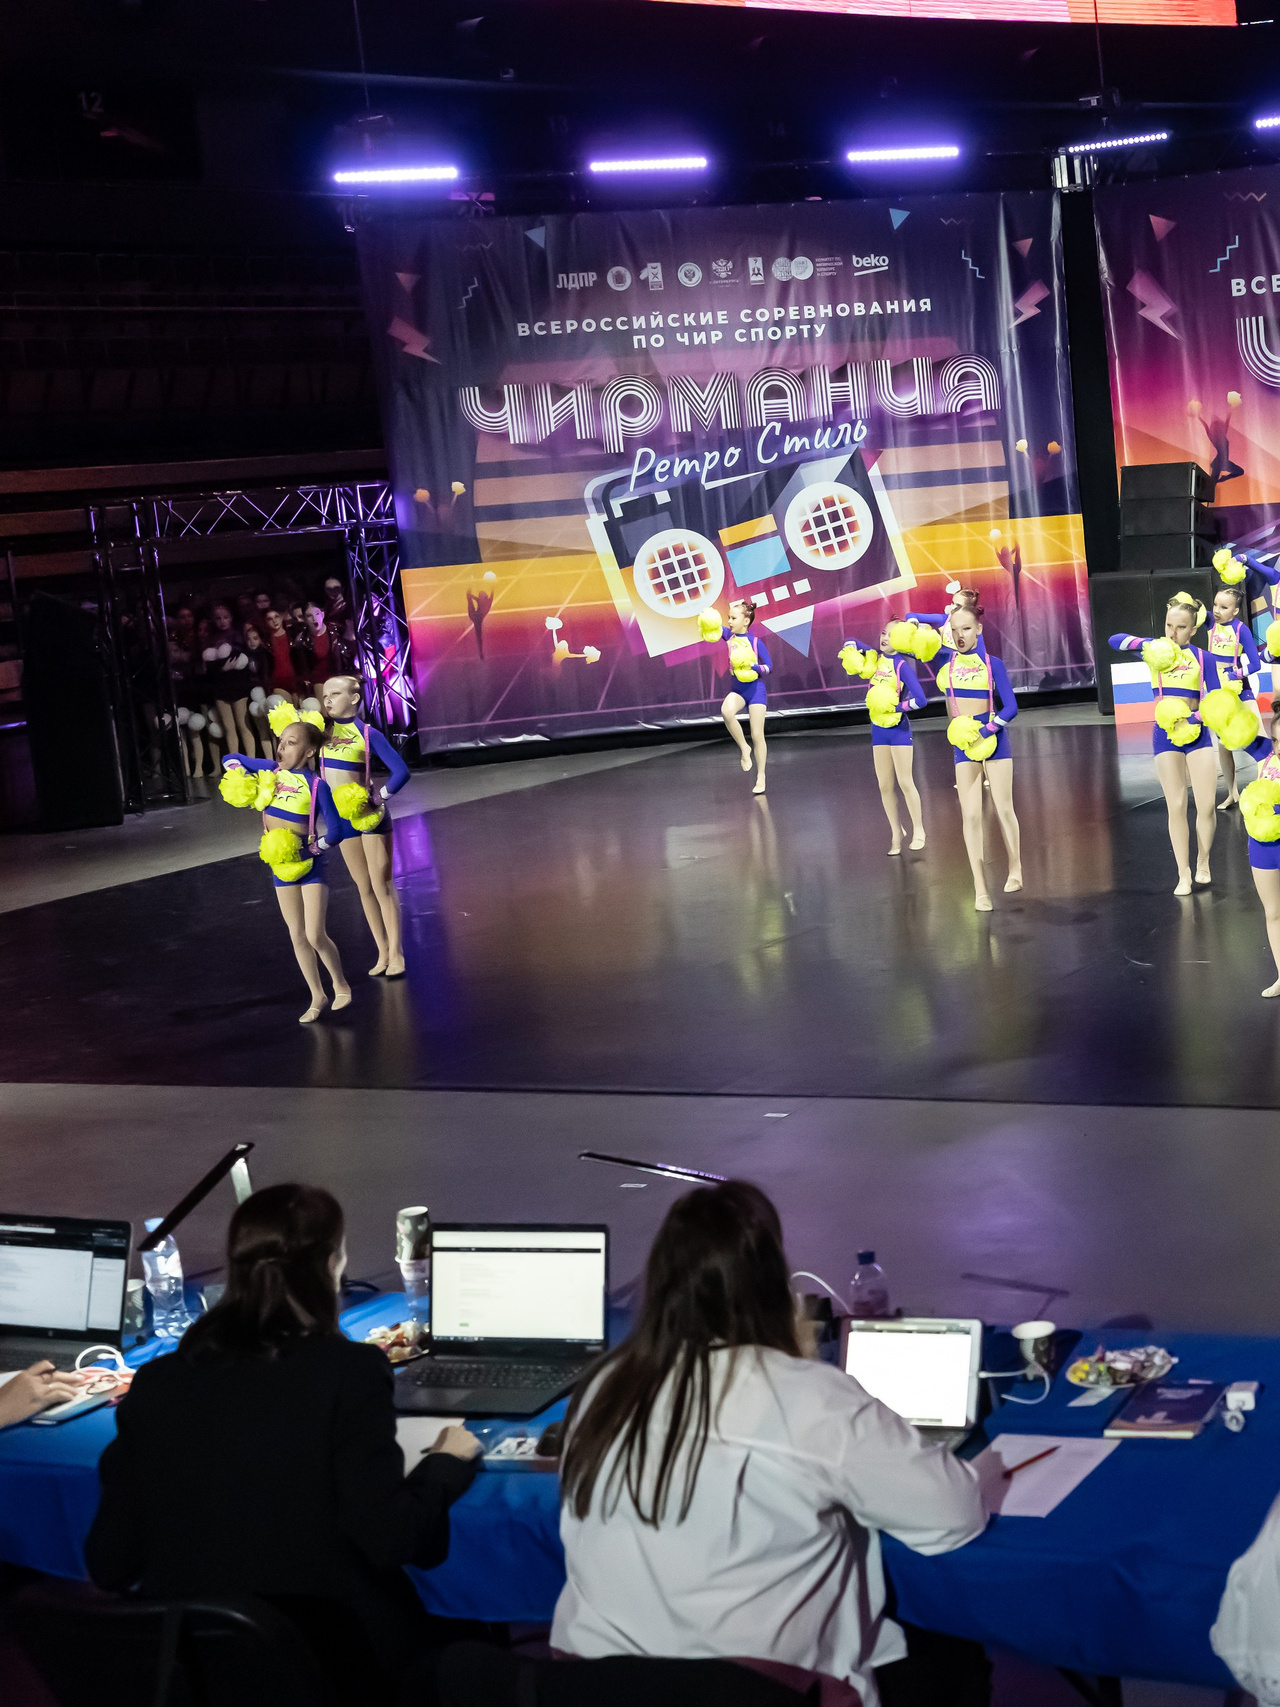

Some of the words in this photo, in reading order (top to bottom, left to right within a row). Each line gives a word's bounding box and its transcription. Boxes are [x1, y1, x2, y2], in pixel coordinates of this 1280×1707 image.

[852, 254, 889, 267] beko
[556, 271, 598, 291] ЛДПР
[517, 310, 729, 337] ВСЕРОССИЙСКИЕ
[740, 298, 932, 324] СОРЕВНОВАНИЯ
[633, 333, 665, 349] ПО
[676, 330, 724, 346] ЧИР
[735, 323, 827, 344] СПОРТУ
[628, 447, 742, 493] Ретро
[757, 419, 869, 465] Стиль
